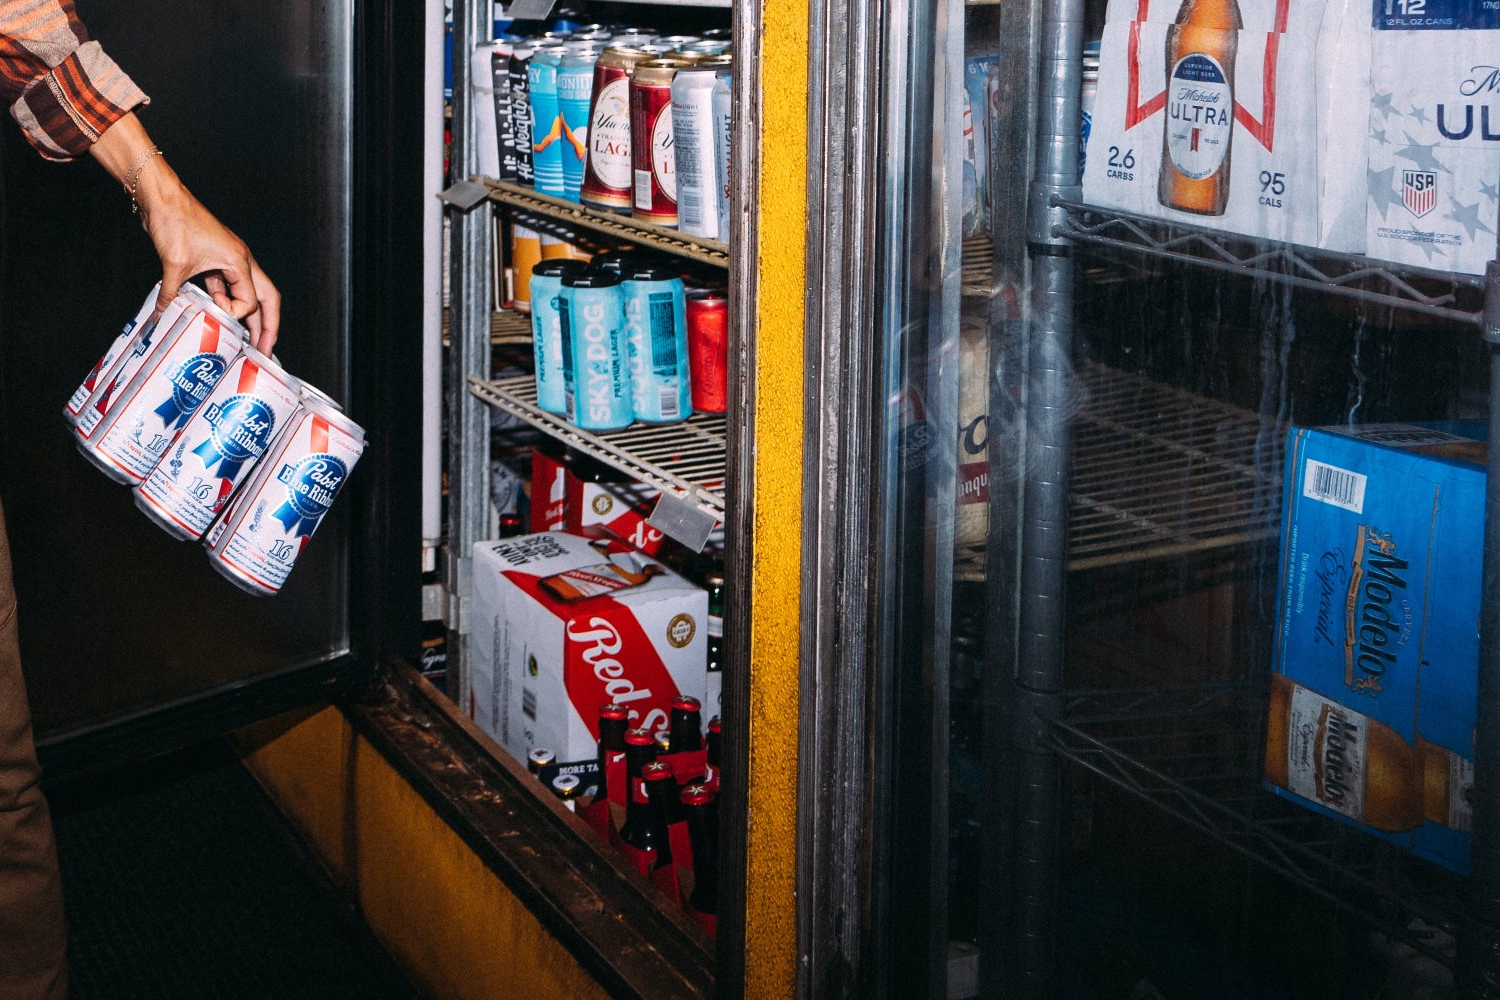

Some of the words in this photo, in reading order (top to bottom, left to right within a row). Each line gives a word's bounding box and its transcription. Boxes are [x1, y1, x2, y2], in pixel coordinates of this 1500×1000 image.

[1425, 18, 1453, 26] CANS
[1178, 87, 1221, 104] Michelob
[1170, 101, 1229, 127] ULTRA
[1107, 145, 1135, 169] 2.6
[1107, 168, 1135, 182] CARBS
[1258, 170, 1286, 194] 95
[1405, 173, 1435, 192] USA
[1258, 195, 1283, 209] CALS
[583, 303, 607, 361] DOG
[609, 328, 619, 357] LAGER
[611, 359, 622, 399] PREMIUM
[587, 367, 612, 422] SKY
[205, 404, 237, 434] Blue
[231, 401, 269, 435] Pabst
[147, 433, 169, 453] 16
[186, 476, 213, 500] 16
[279, 466, 310, 495] Blue
[306, 460, 342, 490] Pabst
[269, 539, 294, 560] 16
[1290, 525, 1298, 563] IMPORTED
[1300, 552, 1309, 571] Drink
[1296, 572, 1306, 615] responsibly
[1356, 547, 1409, 678] Modelo
[567, 616, 653, 703] Red
[559, 765, 586, 776] MORE
[1324, 713, 1358, 802] Modelo
